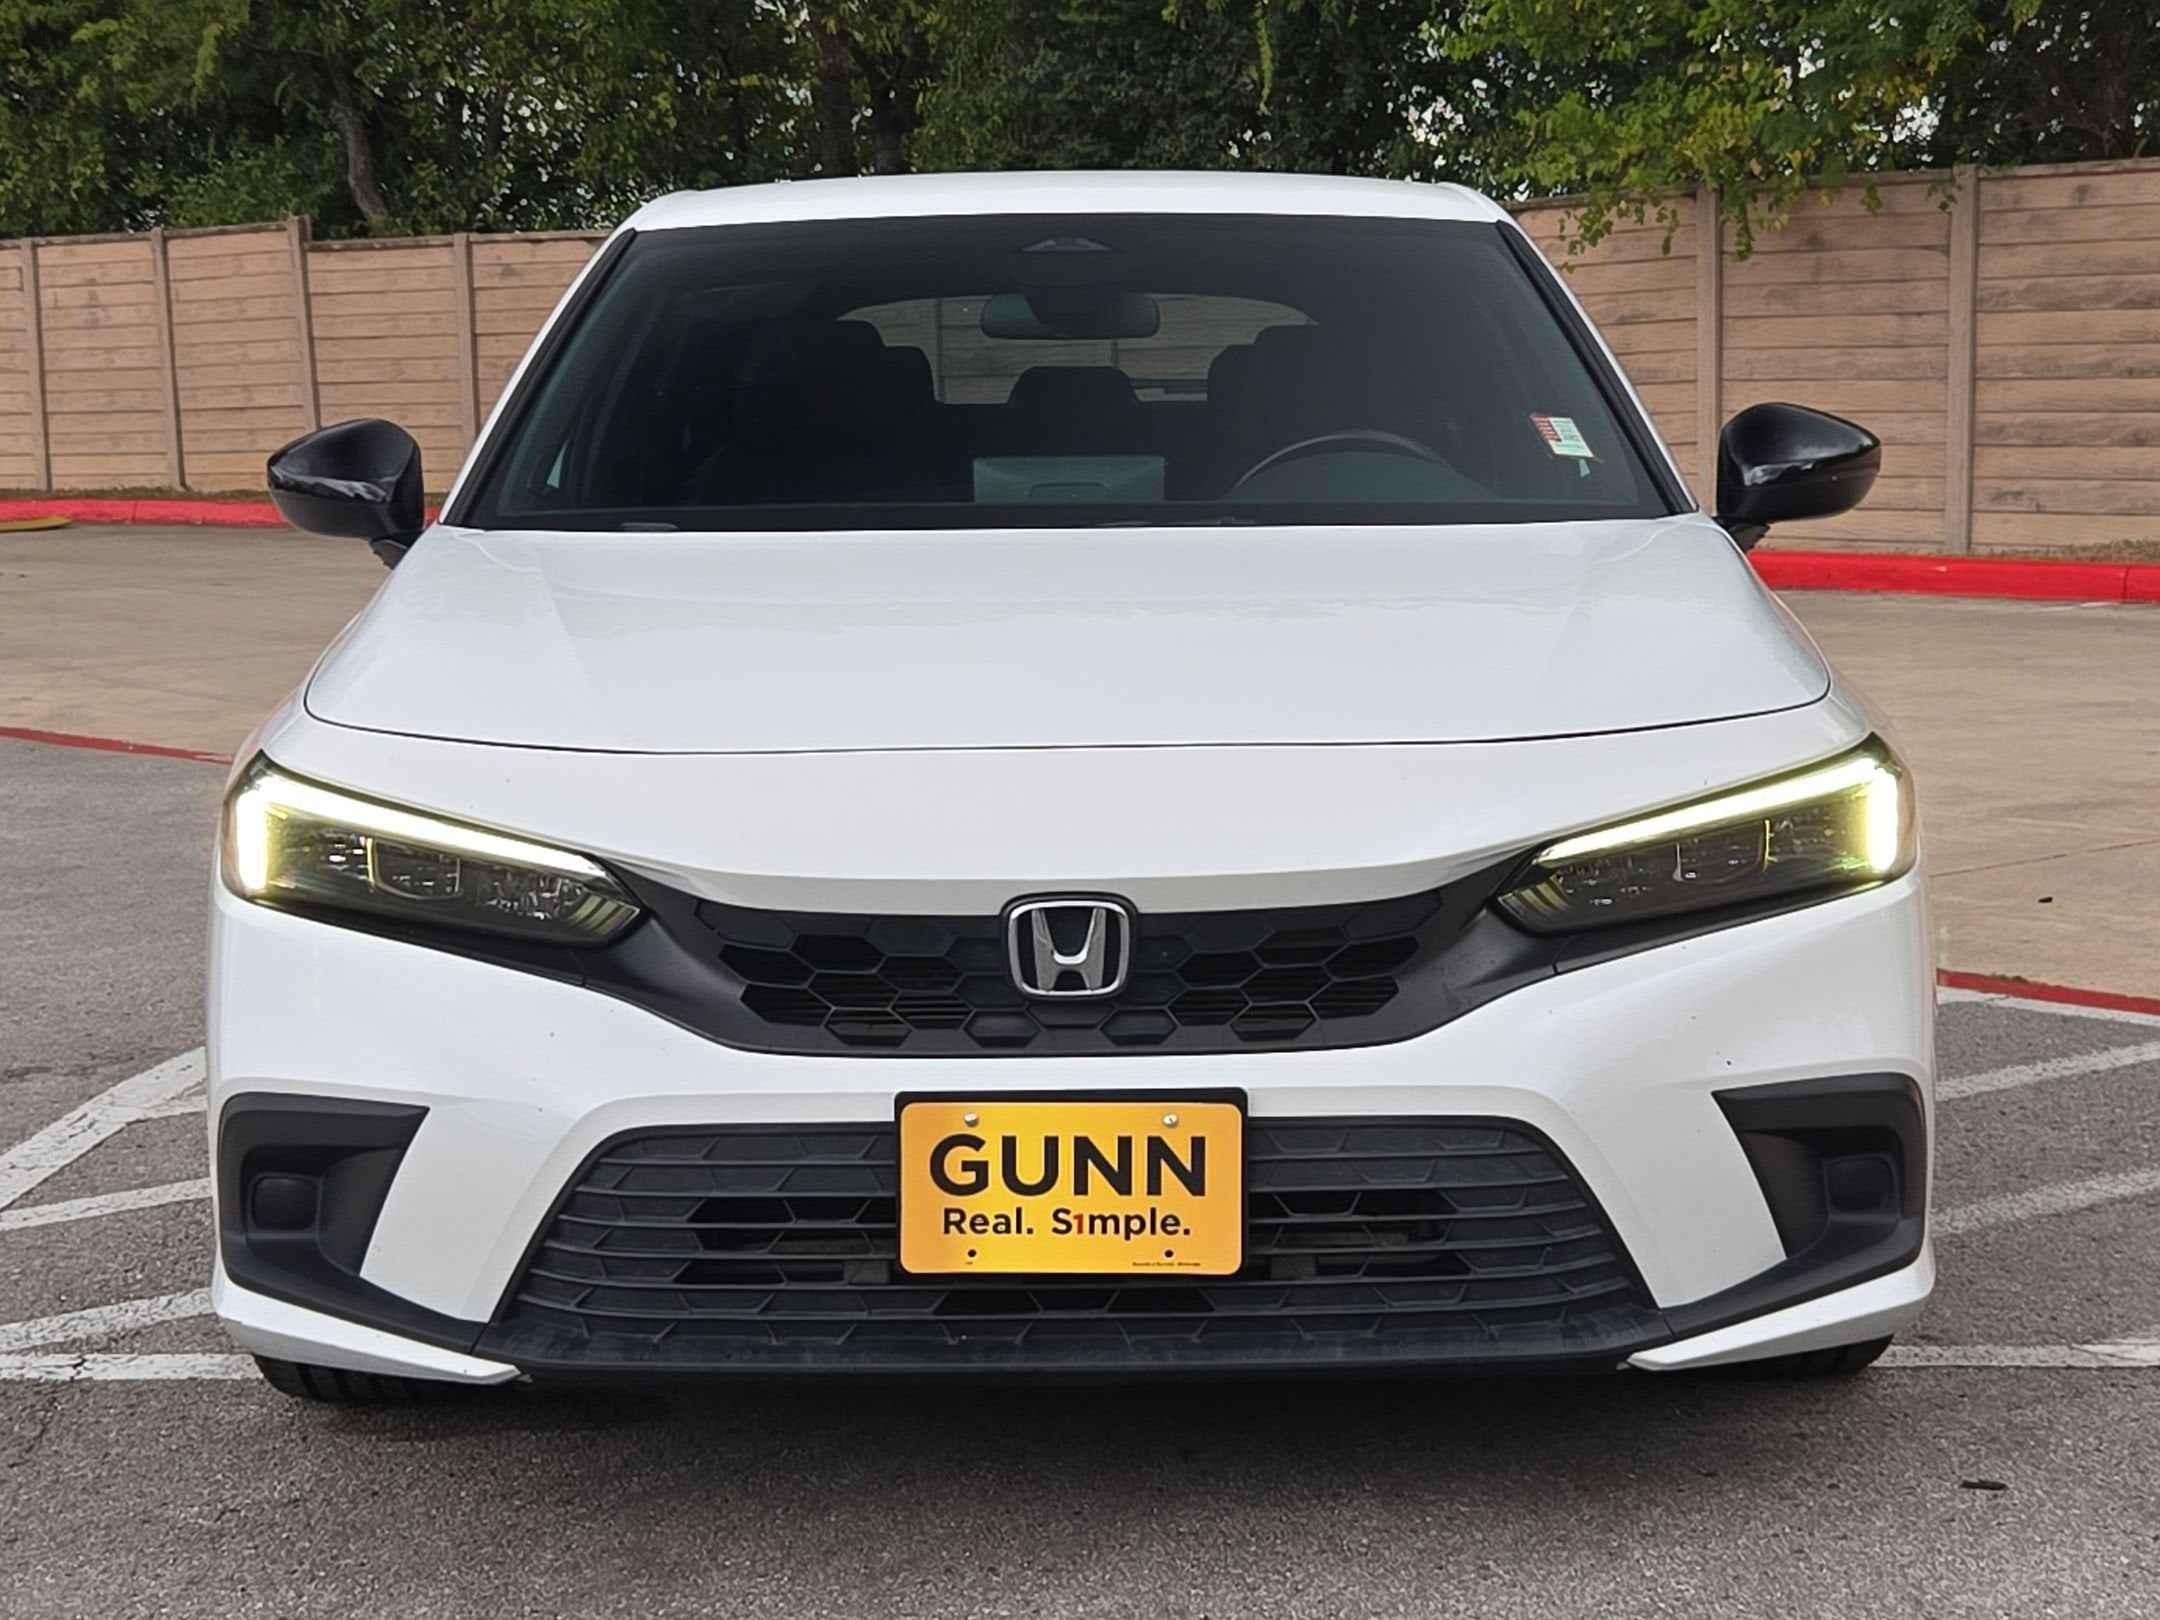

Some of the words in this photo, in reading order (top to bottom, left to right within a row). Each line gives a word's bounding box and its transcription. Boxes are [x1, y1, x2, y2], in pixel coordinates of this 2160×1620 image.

[929, 1133, 1206, 1197] GUNN
[943, 1207, 1034, 1235] Real.
[1052, 1207, 1191, 1241] S1mple.
